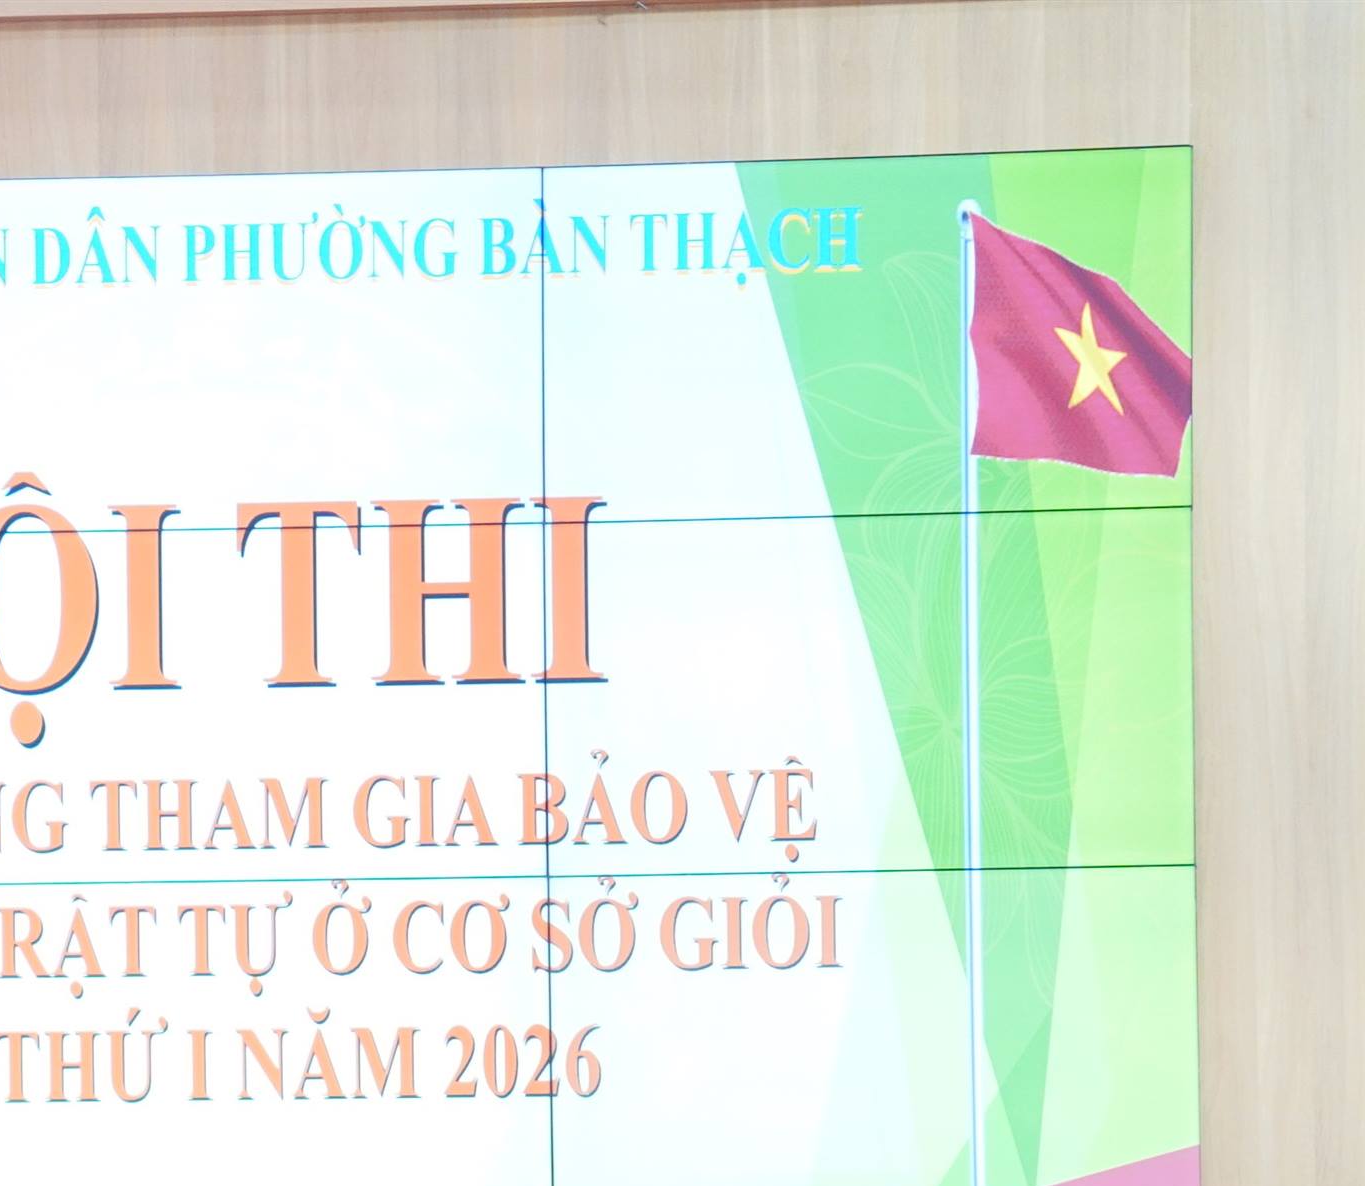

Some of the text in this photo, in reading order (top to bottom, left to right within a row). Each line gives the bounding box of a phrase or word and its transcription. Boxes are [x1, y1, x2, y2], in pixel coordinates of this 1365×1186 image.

[31, 204, 161, 289] DÂN
[182, 203, 459, 285] PHƯỜNG
[477, 198, 609, 280] BÀN
[629, 204, 865, 289] THẠCH
[235, 495, 609, 688] THI
[88, 775, 330, 852] THAM
[352, 773, 501, 849] GIA
[516, 748, 689, 846] BẢO
[709, 755, 818, 862] VỆ
[177, 889, 293, 996] TỰ
[311, 879, 372, 977] Ở
[392, 893, 510, 975] CƠ
[531, 875, 639, 974] SỞ
[659, 871, 843, 971] GIỎI
[187, 1028, 213, 1102] I
[236, 1005, 422, 1101] NĂM
[443, 1022, 602, 1100] 2026
